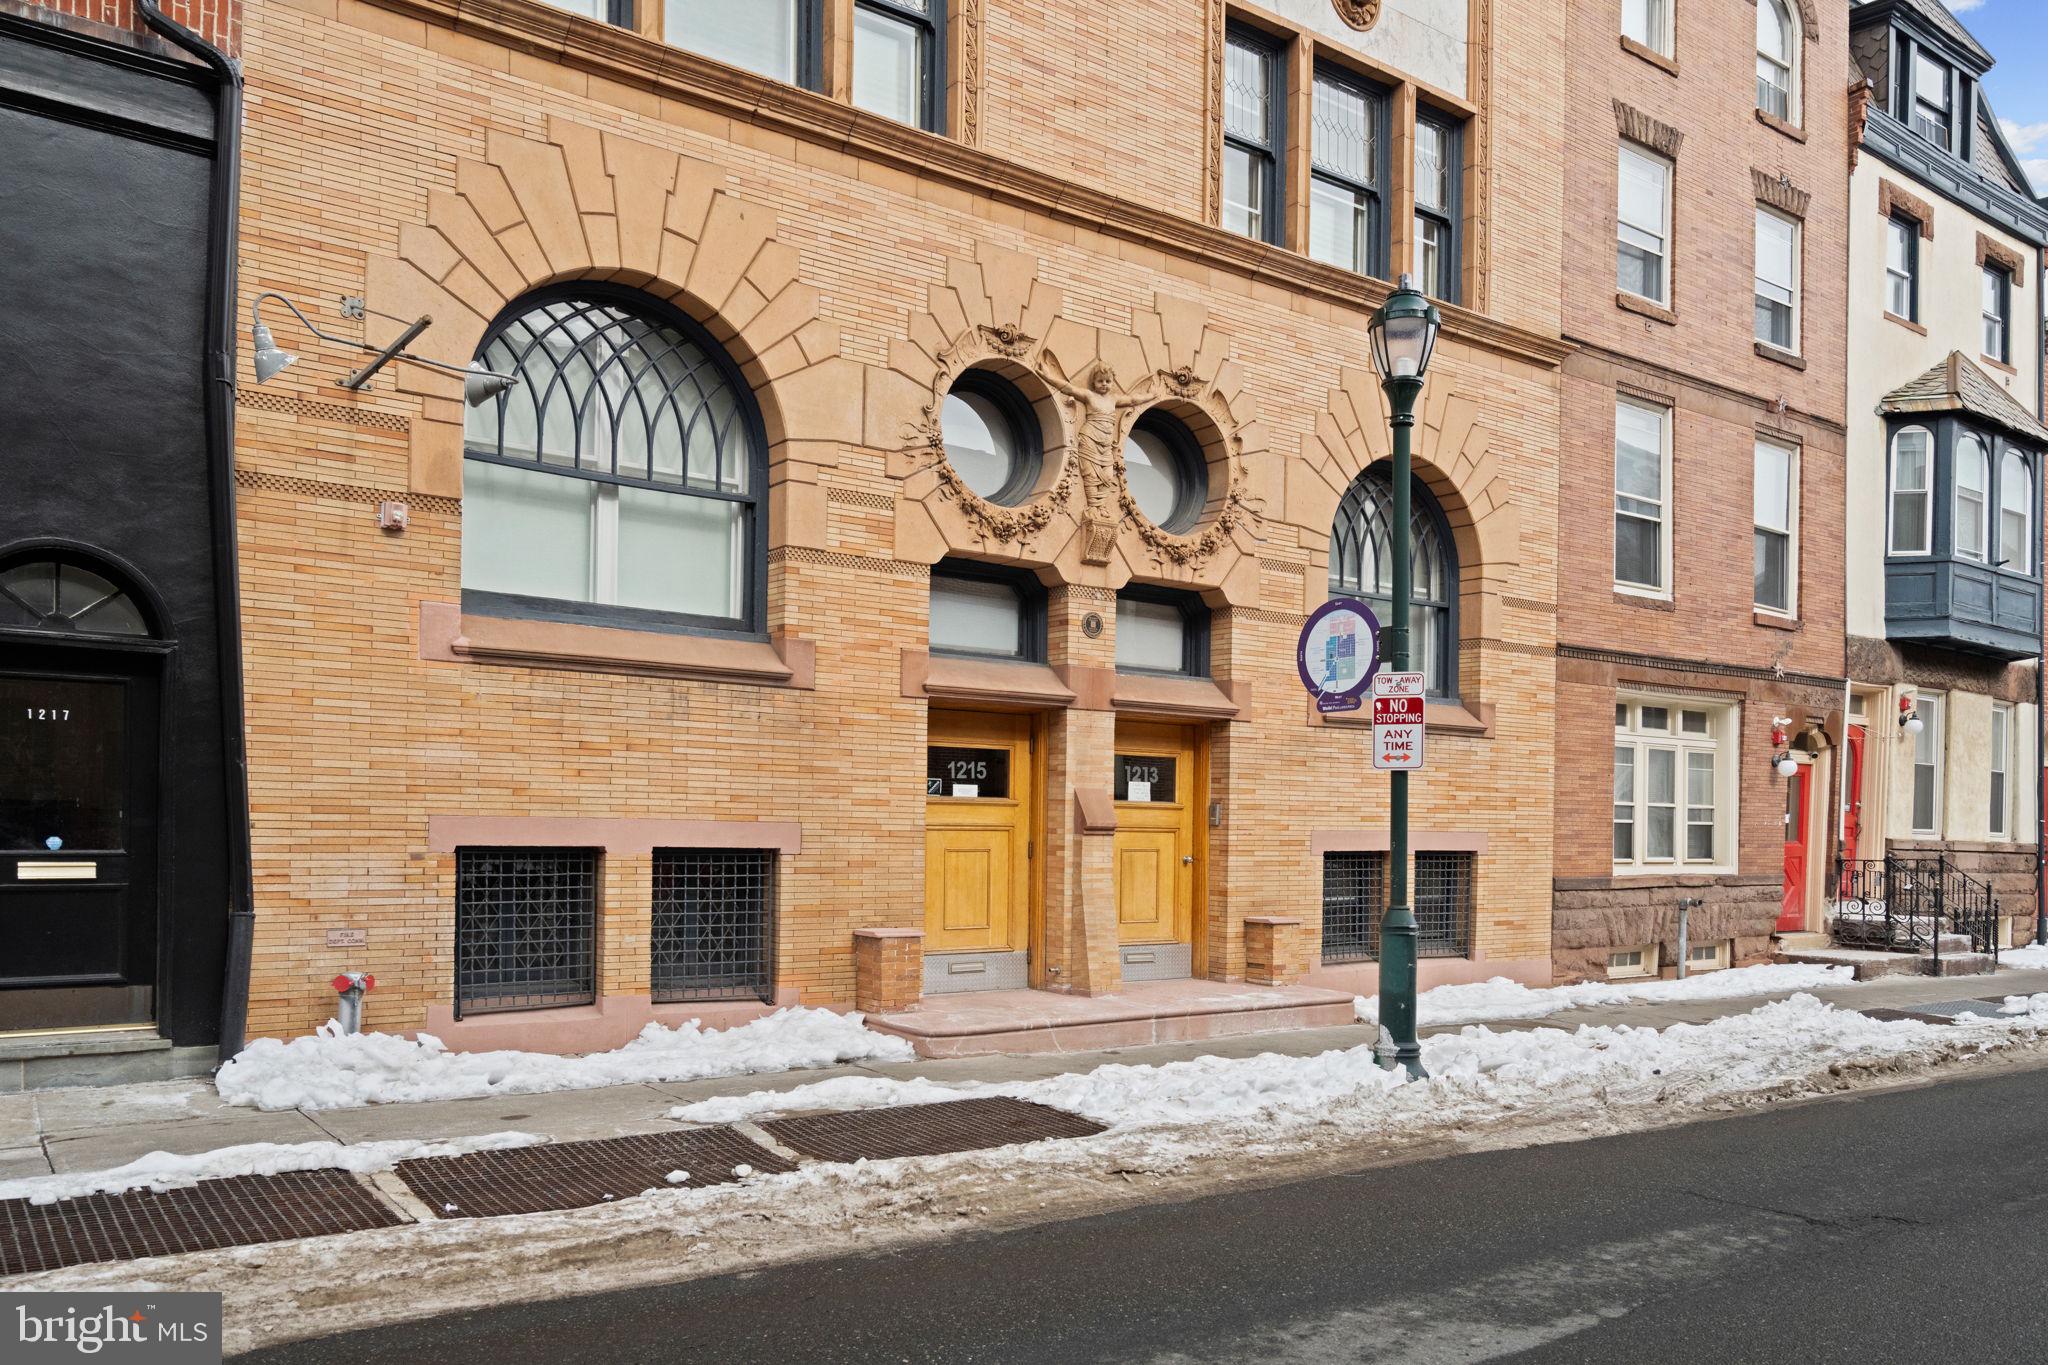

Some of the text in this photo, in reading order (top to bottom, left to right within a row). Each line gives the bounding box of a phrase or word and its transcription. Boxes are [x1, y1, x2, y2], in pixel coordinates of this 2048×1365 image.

[1390, 699, 1407, 712] NO
[28, 709, 69, 720] 1217
[1376, 713, 1421, 724] STOPPING
[1384, 730, 1413, 739] ANY
[1384, 742, 1413, 750] TIME
[948, 761, 987, 779] 1215
[1125, 766, 1159, 783] 1213
